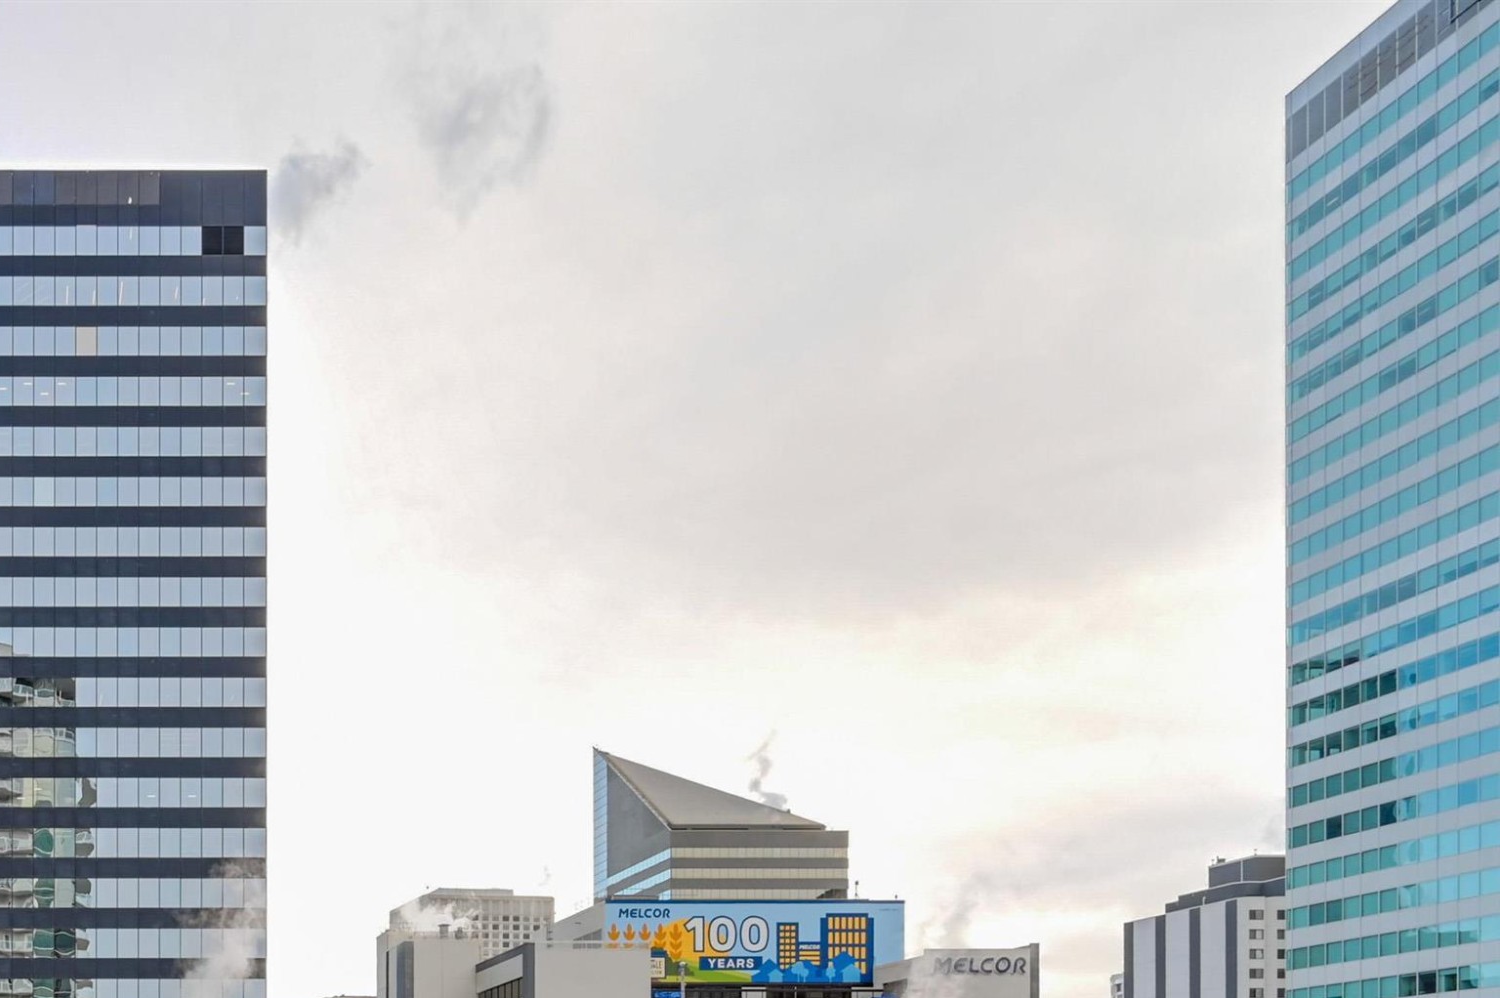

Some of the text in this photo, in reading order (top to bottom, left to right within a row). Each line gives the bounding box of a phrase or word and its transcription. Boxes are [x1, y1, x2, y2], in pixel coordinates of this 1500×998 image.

[618, 908, 670, 918] MELCOR
[683, 915, 770, 952] 100
[707, 958, 755, 969] YEARS
[933, 957, 1027, 974] MELCOR
